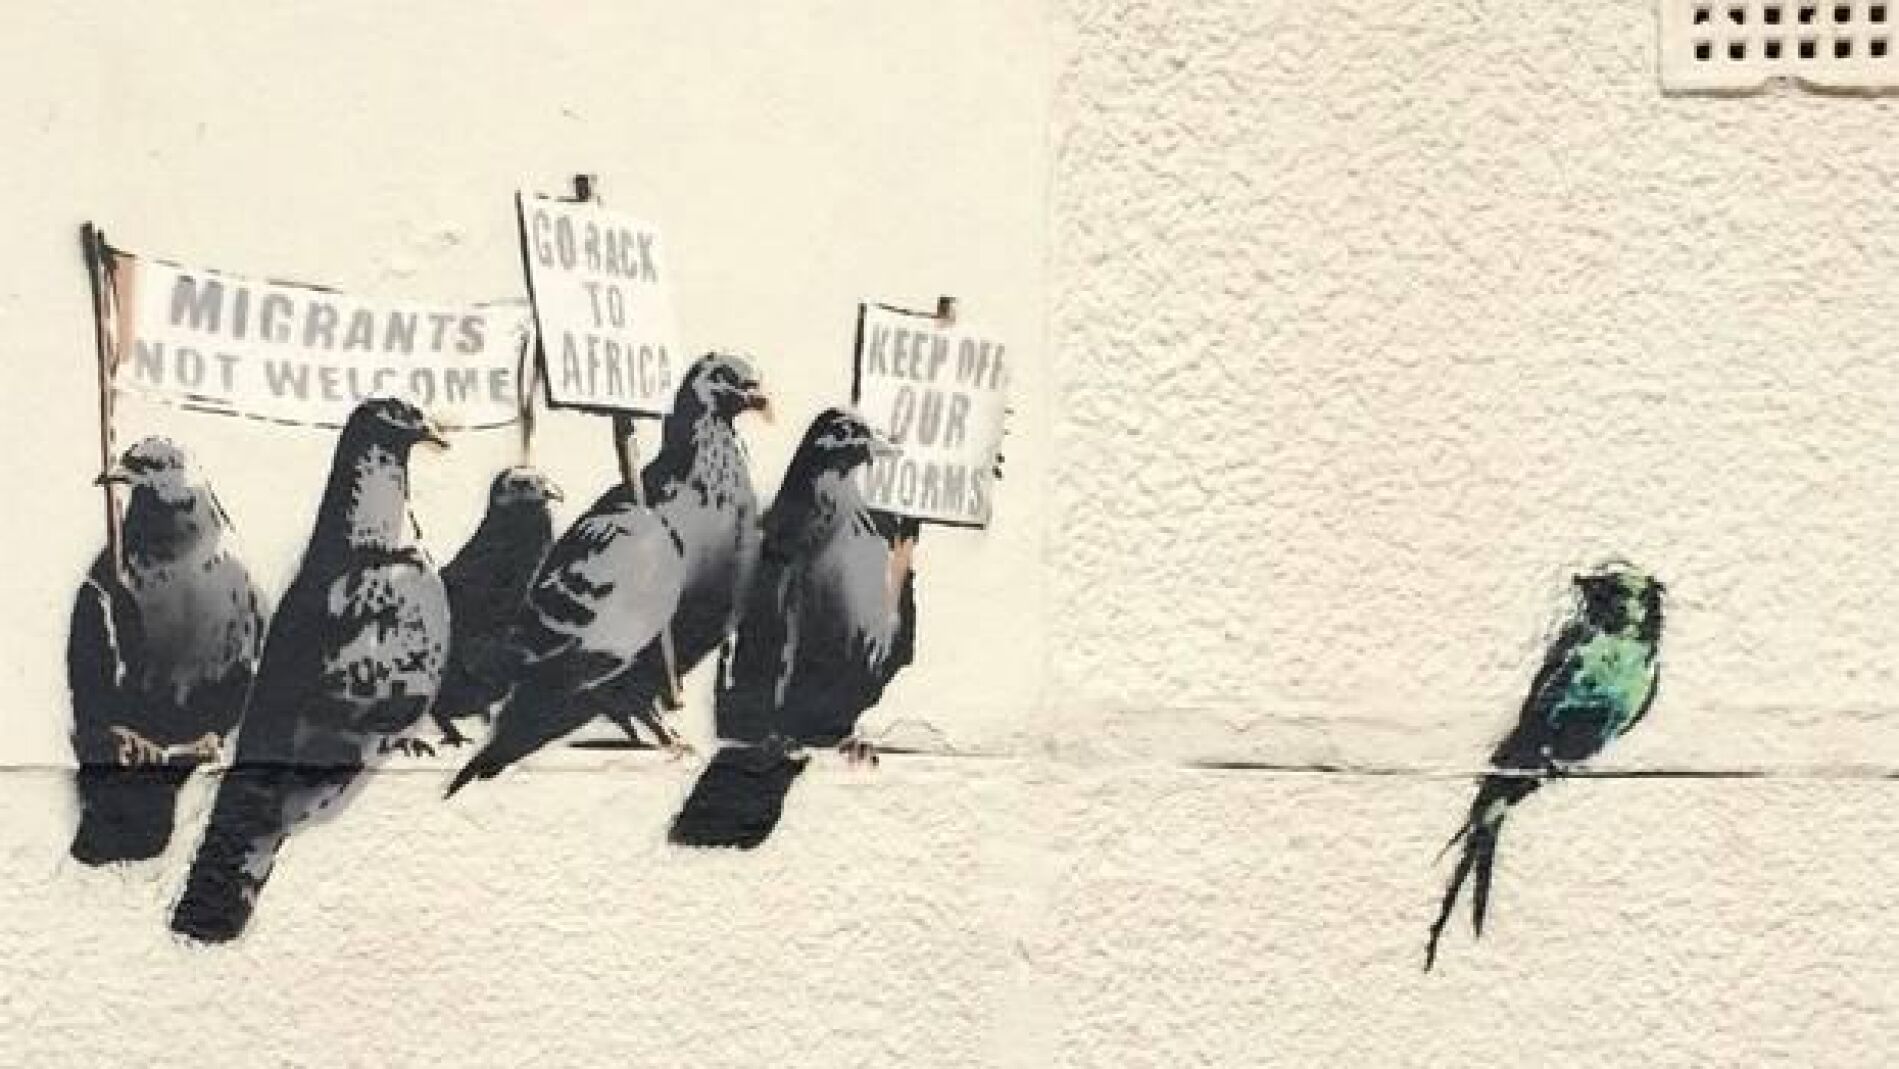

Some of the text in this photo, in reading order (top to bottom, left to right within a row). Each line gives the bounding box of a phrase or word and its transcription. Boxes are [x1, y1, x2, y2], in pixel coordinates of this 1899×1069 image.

[533, 208, 659, 282] GO BACK
[169, 275, 486, 353] MIGRANTS
[582, 281, 626, 329] TO
[133, 341, 512, 404] NOT WELCOME
[868, 322, 949, 381] KEEP
[889, 385, 971, 448] OUR
[866, 456, 984, 516] WORMS
